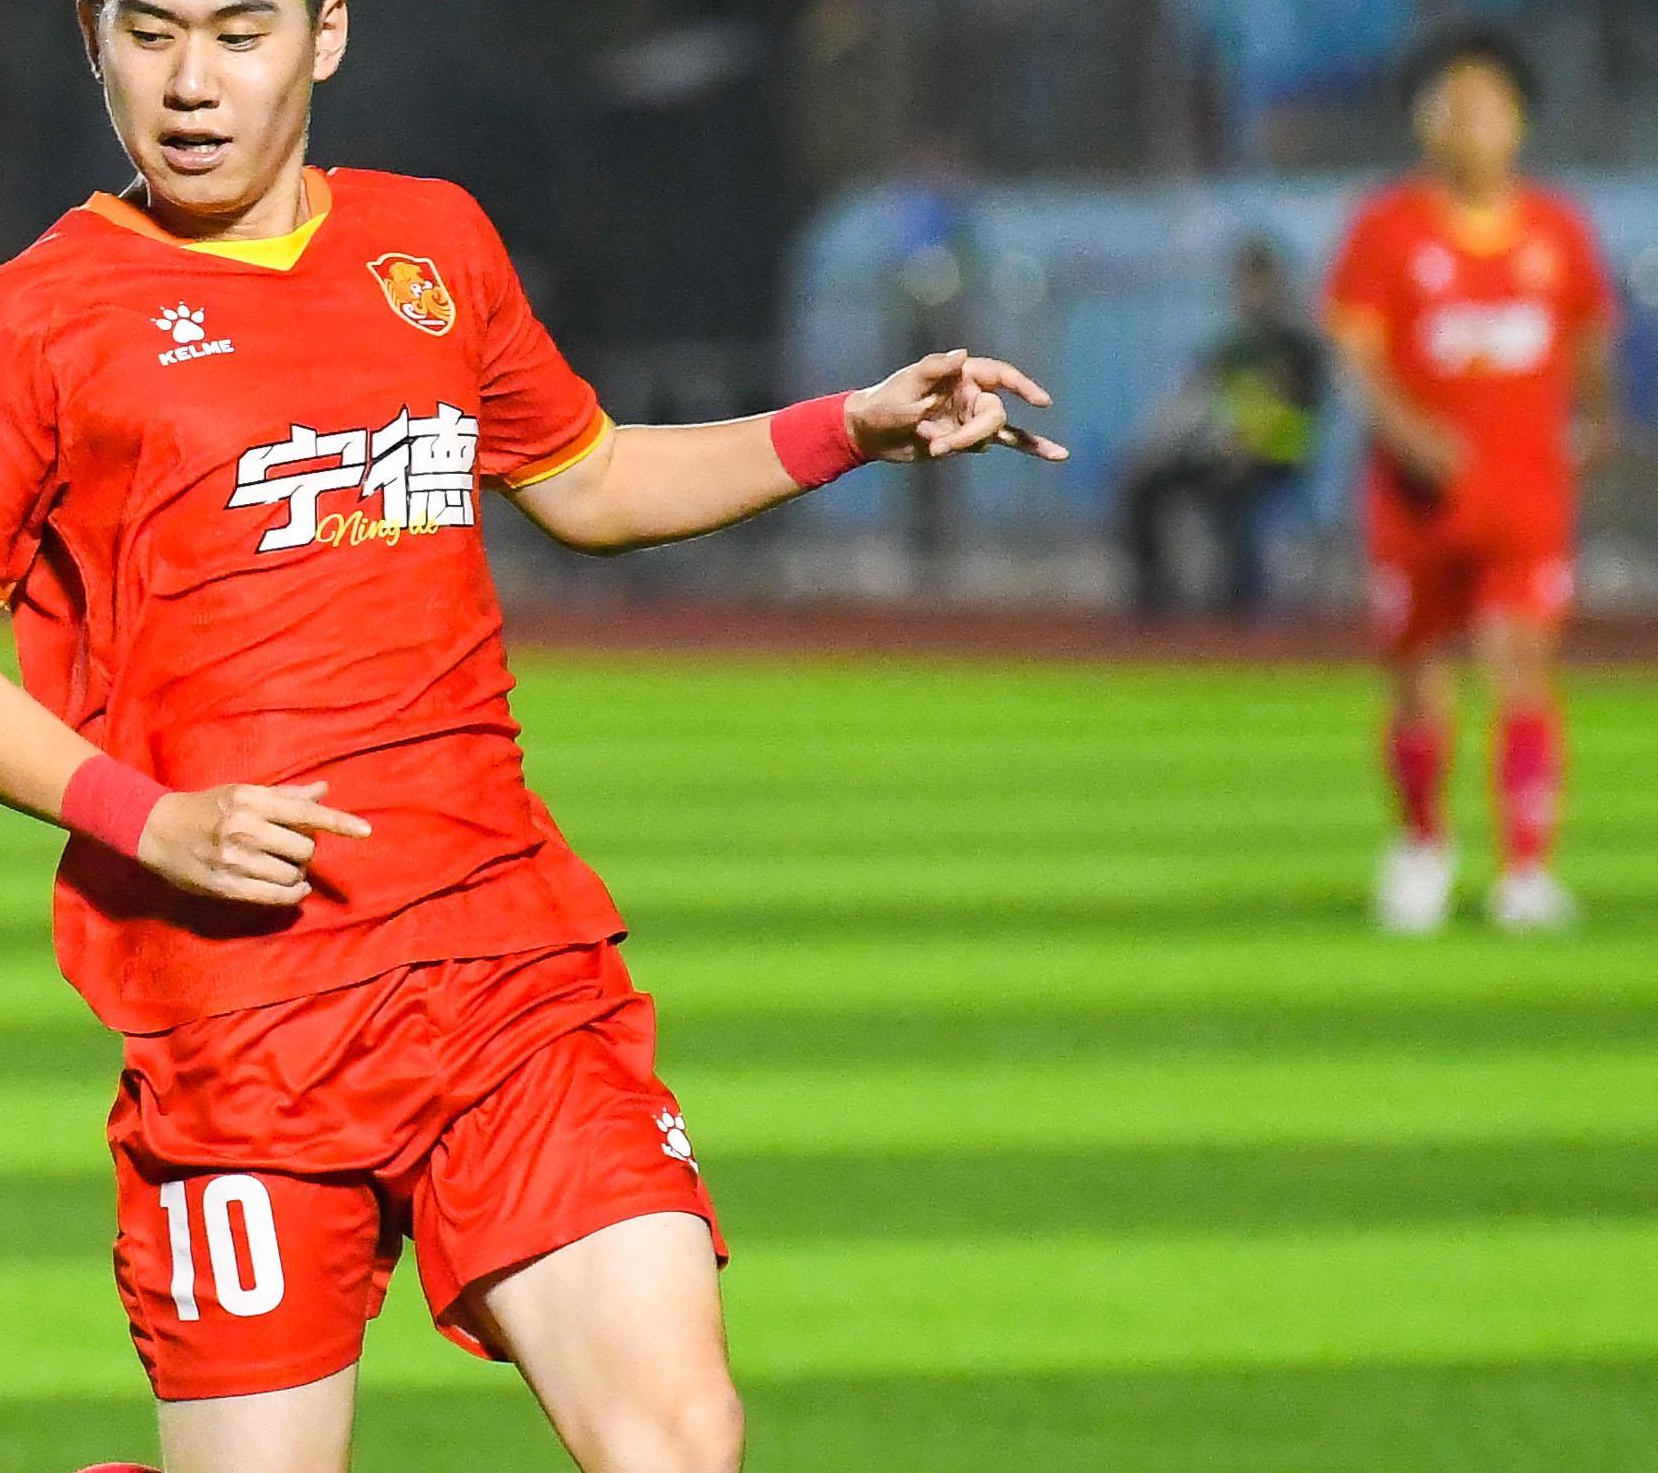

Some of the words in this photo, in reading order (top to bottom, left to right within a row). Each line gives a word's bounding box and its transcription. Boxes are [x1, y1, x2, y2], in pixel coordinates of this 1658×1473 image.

[158, 339, 235, 366] KELME
[224, 401, 480, 554] 宁德
[160, 1173, 286, 1322] 10
